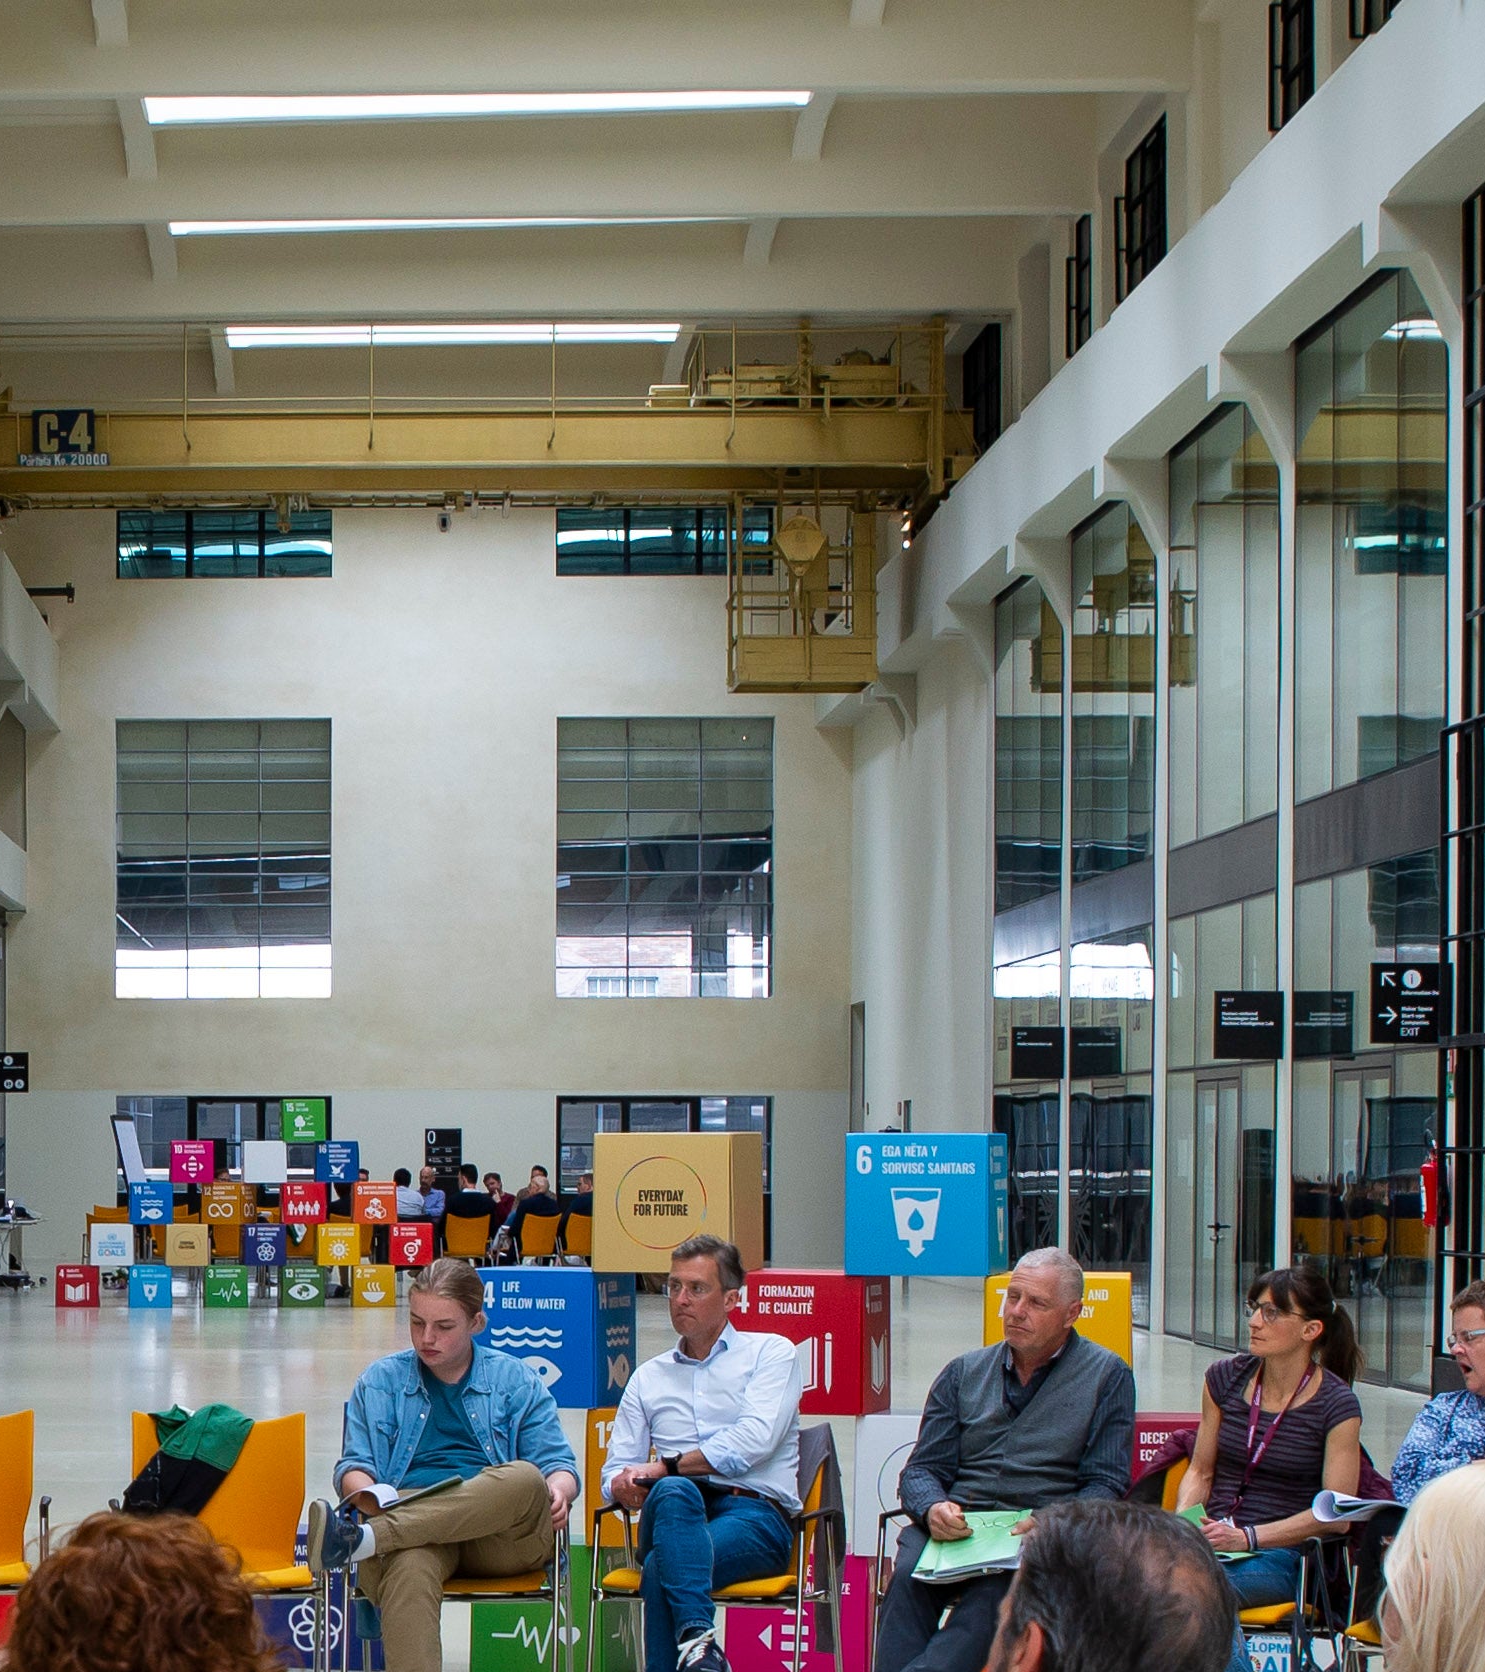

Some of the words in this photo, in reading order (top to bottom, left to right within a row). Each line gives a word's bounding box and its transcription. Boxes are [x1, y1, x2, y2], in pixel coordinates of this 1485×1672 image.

[39, 412, 92, 452] C-4
[71, 453, 108, 466] 20000
[1400, 1027, 1420, 1036] EXIT
[856, 1145, 872, 1175] 6
[882, 1145, 901, 1157] EGA
[904, 1143, 928, 1157] NËTA
[931, 1145, 938, 1157] Y
[882, 1162, 924, 1174] SORVISC
[928, 1162, 976, 1175] SANITARS
[133, 1186, 142, 1195] 14
[357, 1185, 363, 1195] 9
[638, 1190, 684, 1202] EVERYDAY
[633, 1204, 651, 1216] FOR
[653, 1204, 689, 1216] FUTURE
[208, 1269, 214, 1278] 3
[285, 1268, 293, 1278] 13
[356, 1268, 363, 1278] 2
[484, 1281, 495, 1309] 4
[502, 1281, 520, 1293] LIFE
[758, 1285, 815, 1298] FORMAZIUN
[1088, 1290, 1109, 1301] AND
[502, 1298, 533, 1310] BELOW
[536, 1298, 565, 1310] WATER
[758, 1302, 771, 1314] DE
[773, 1300, 813, 1315] CUALITÉ
